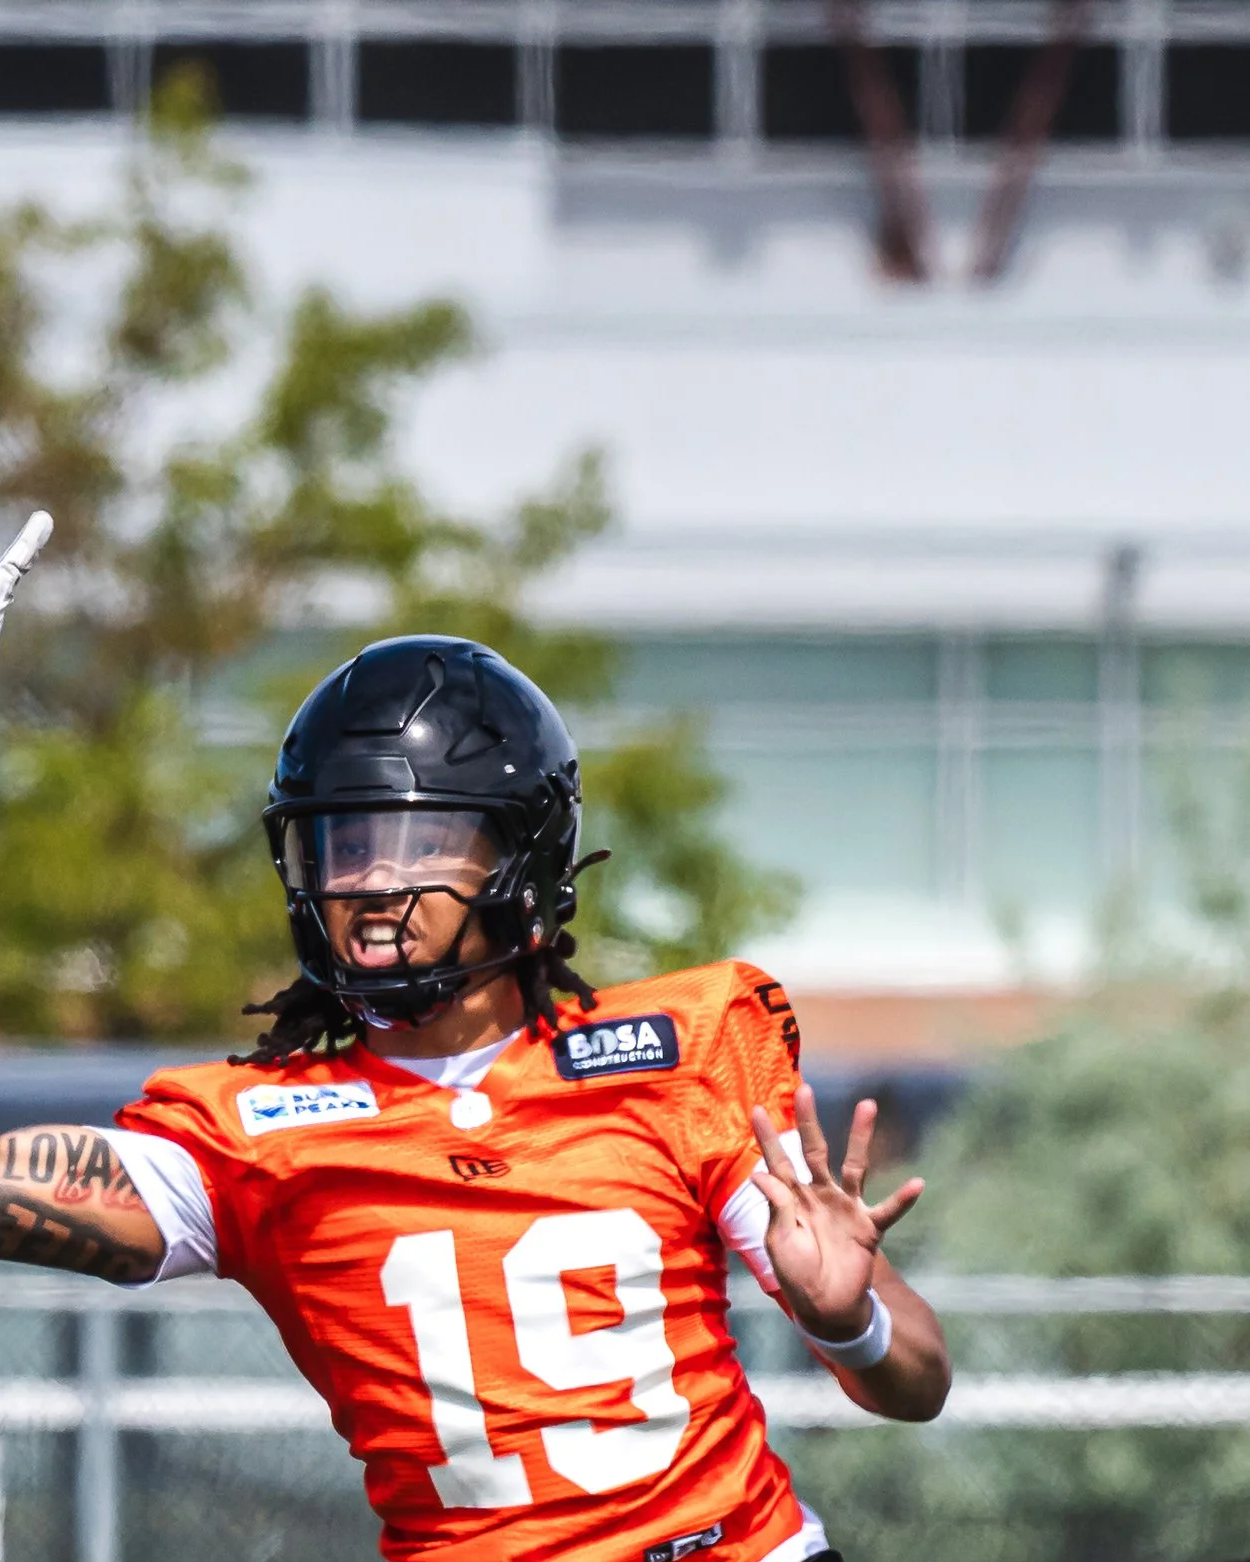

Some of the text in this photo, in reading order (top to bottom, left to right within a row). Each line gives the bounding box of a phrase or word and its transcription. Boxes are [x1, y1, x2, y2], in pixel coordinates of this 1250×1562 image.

[567, 1021, 661, 1059] BOSA
[572, 1048, 664, 1069] CONSTRUCTION
[380, 1208, 690, 1508] 19
